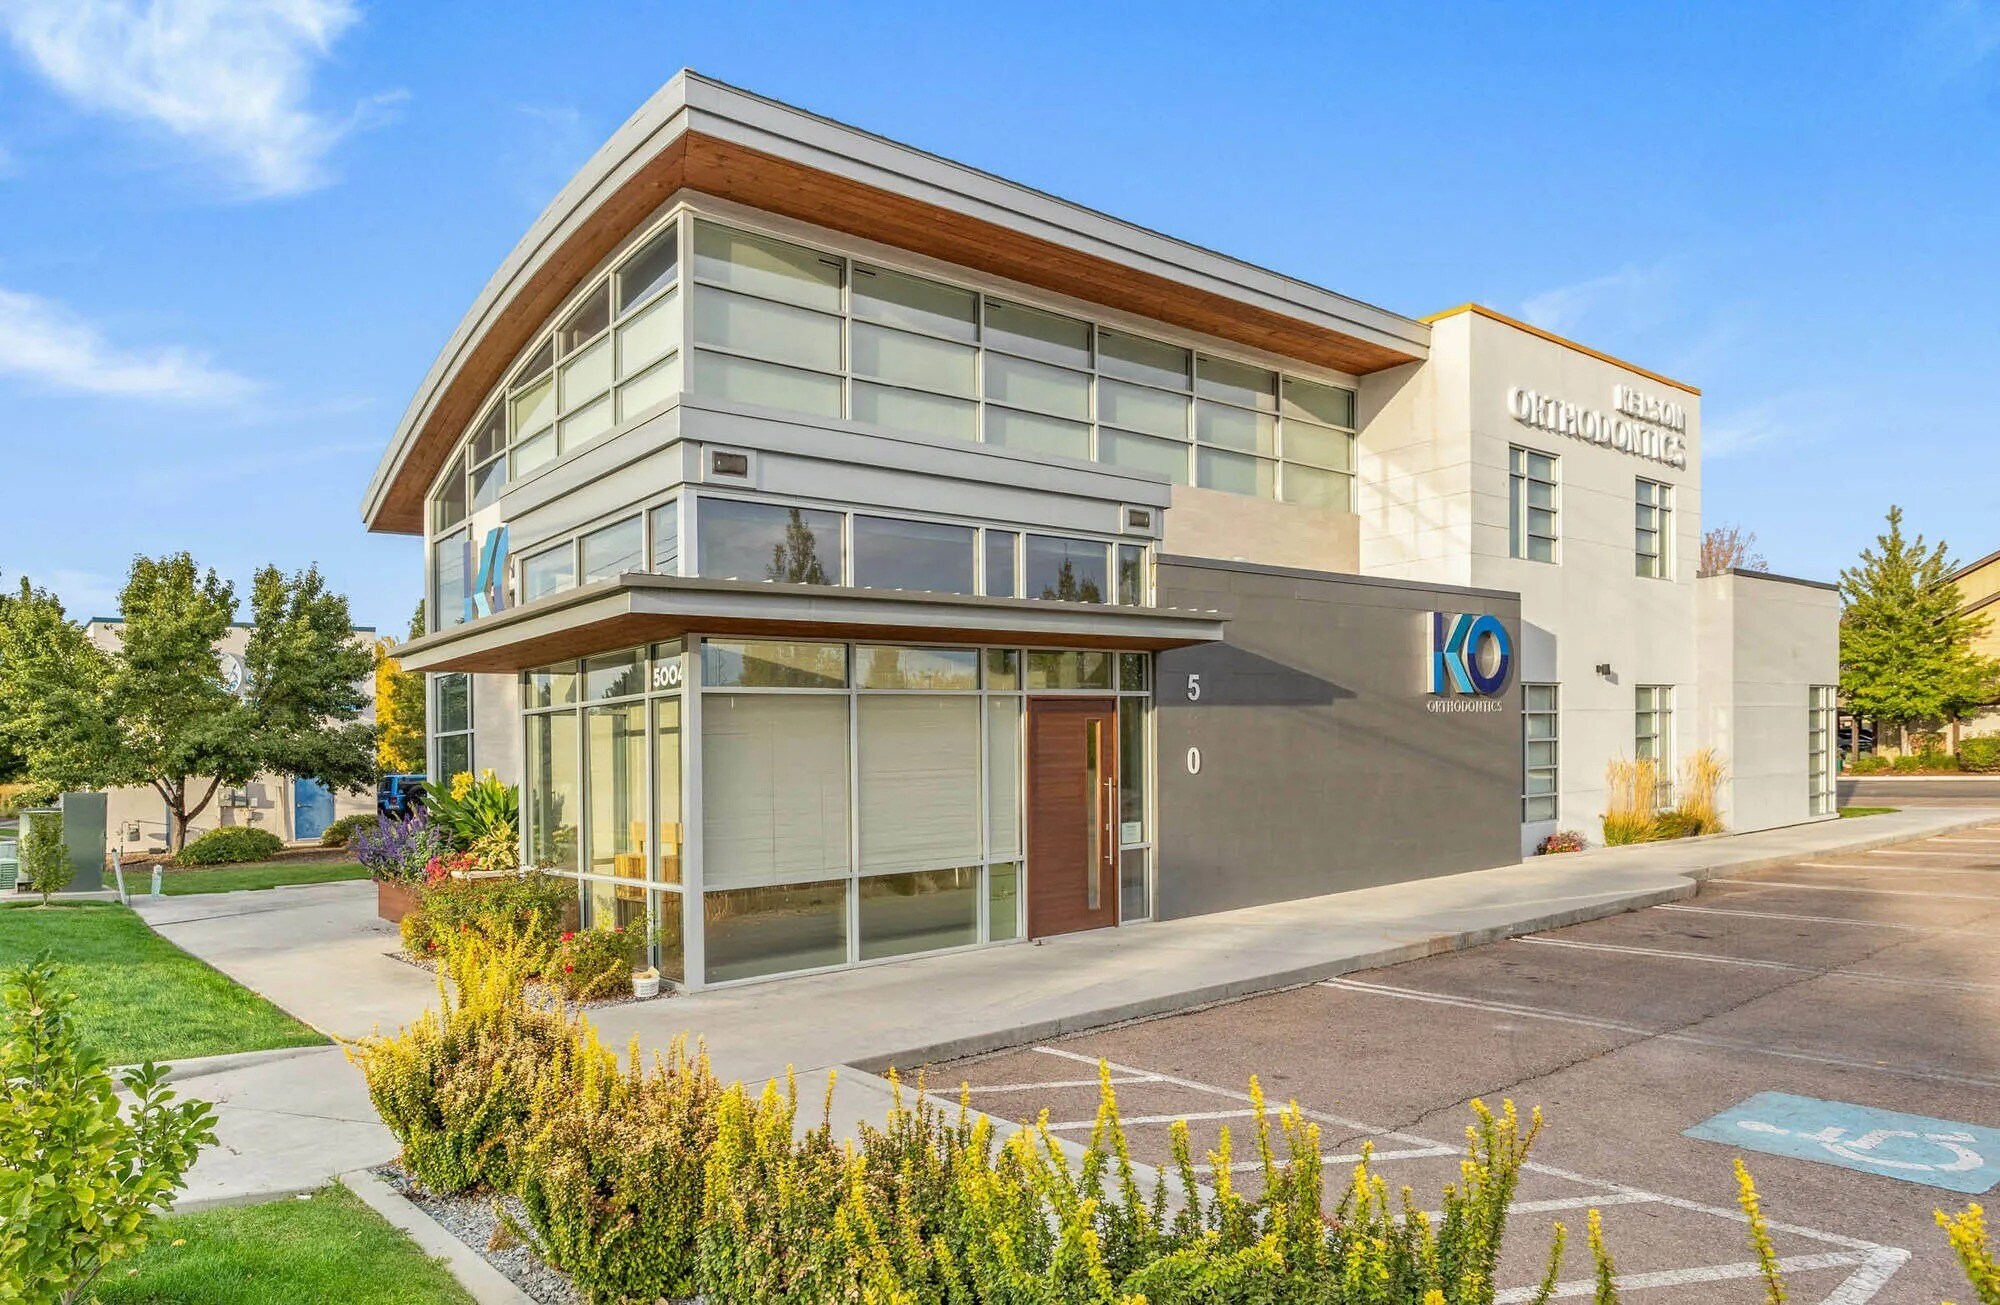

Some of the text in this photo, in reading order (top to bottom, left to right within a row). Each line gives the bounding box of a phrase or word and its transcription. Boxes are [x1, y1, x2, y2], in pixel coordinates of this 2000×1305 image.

[1508, 386, 1686, 466] ORTHODONTICS
[1427, 612, 1509, 693] KO
[1187, 674, 1200, 774] 5 0
[1427, 700, 1502, 712] ORTHODONTICS
